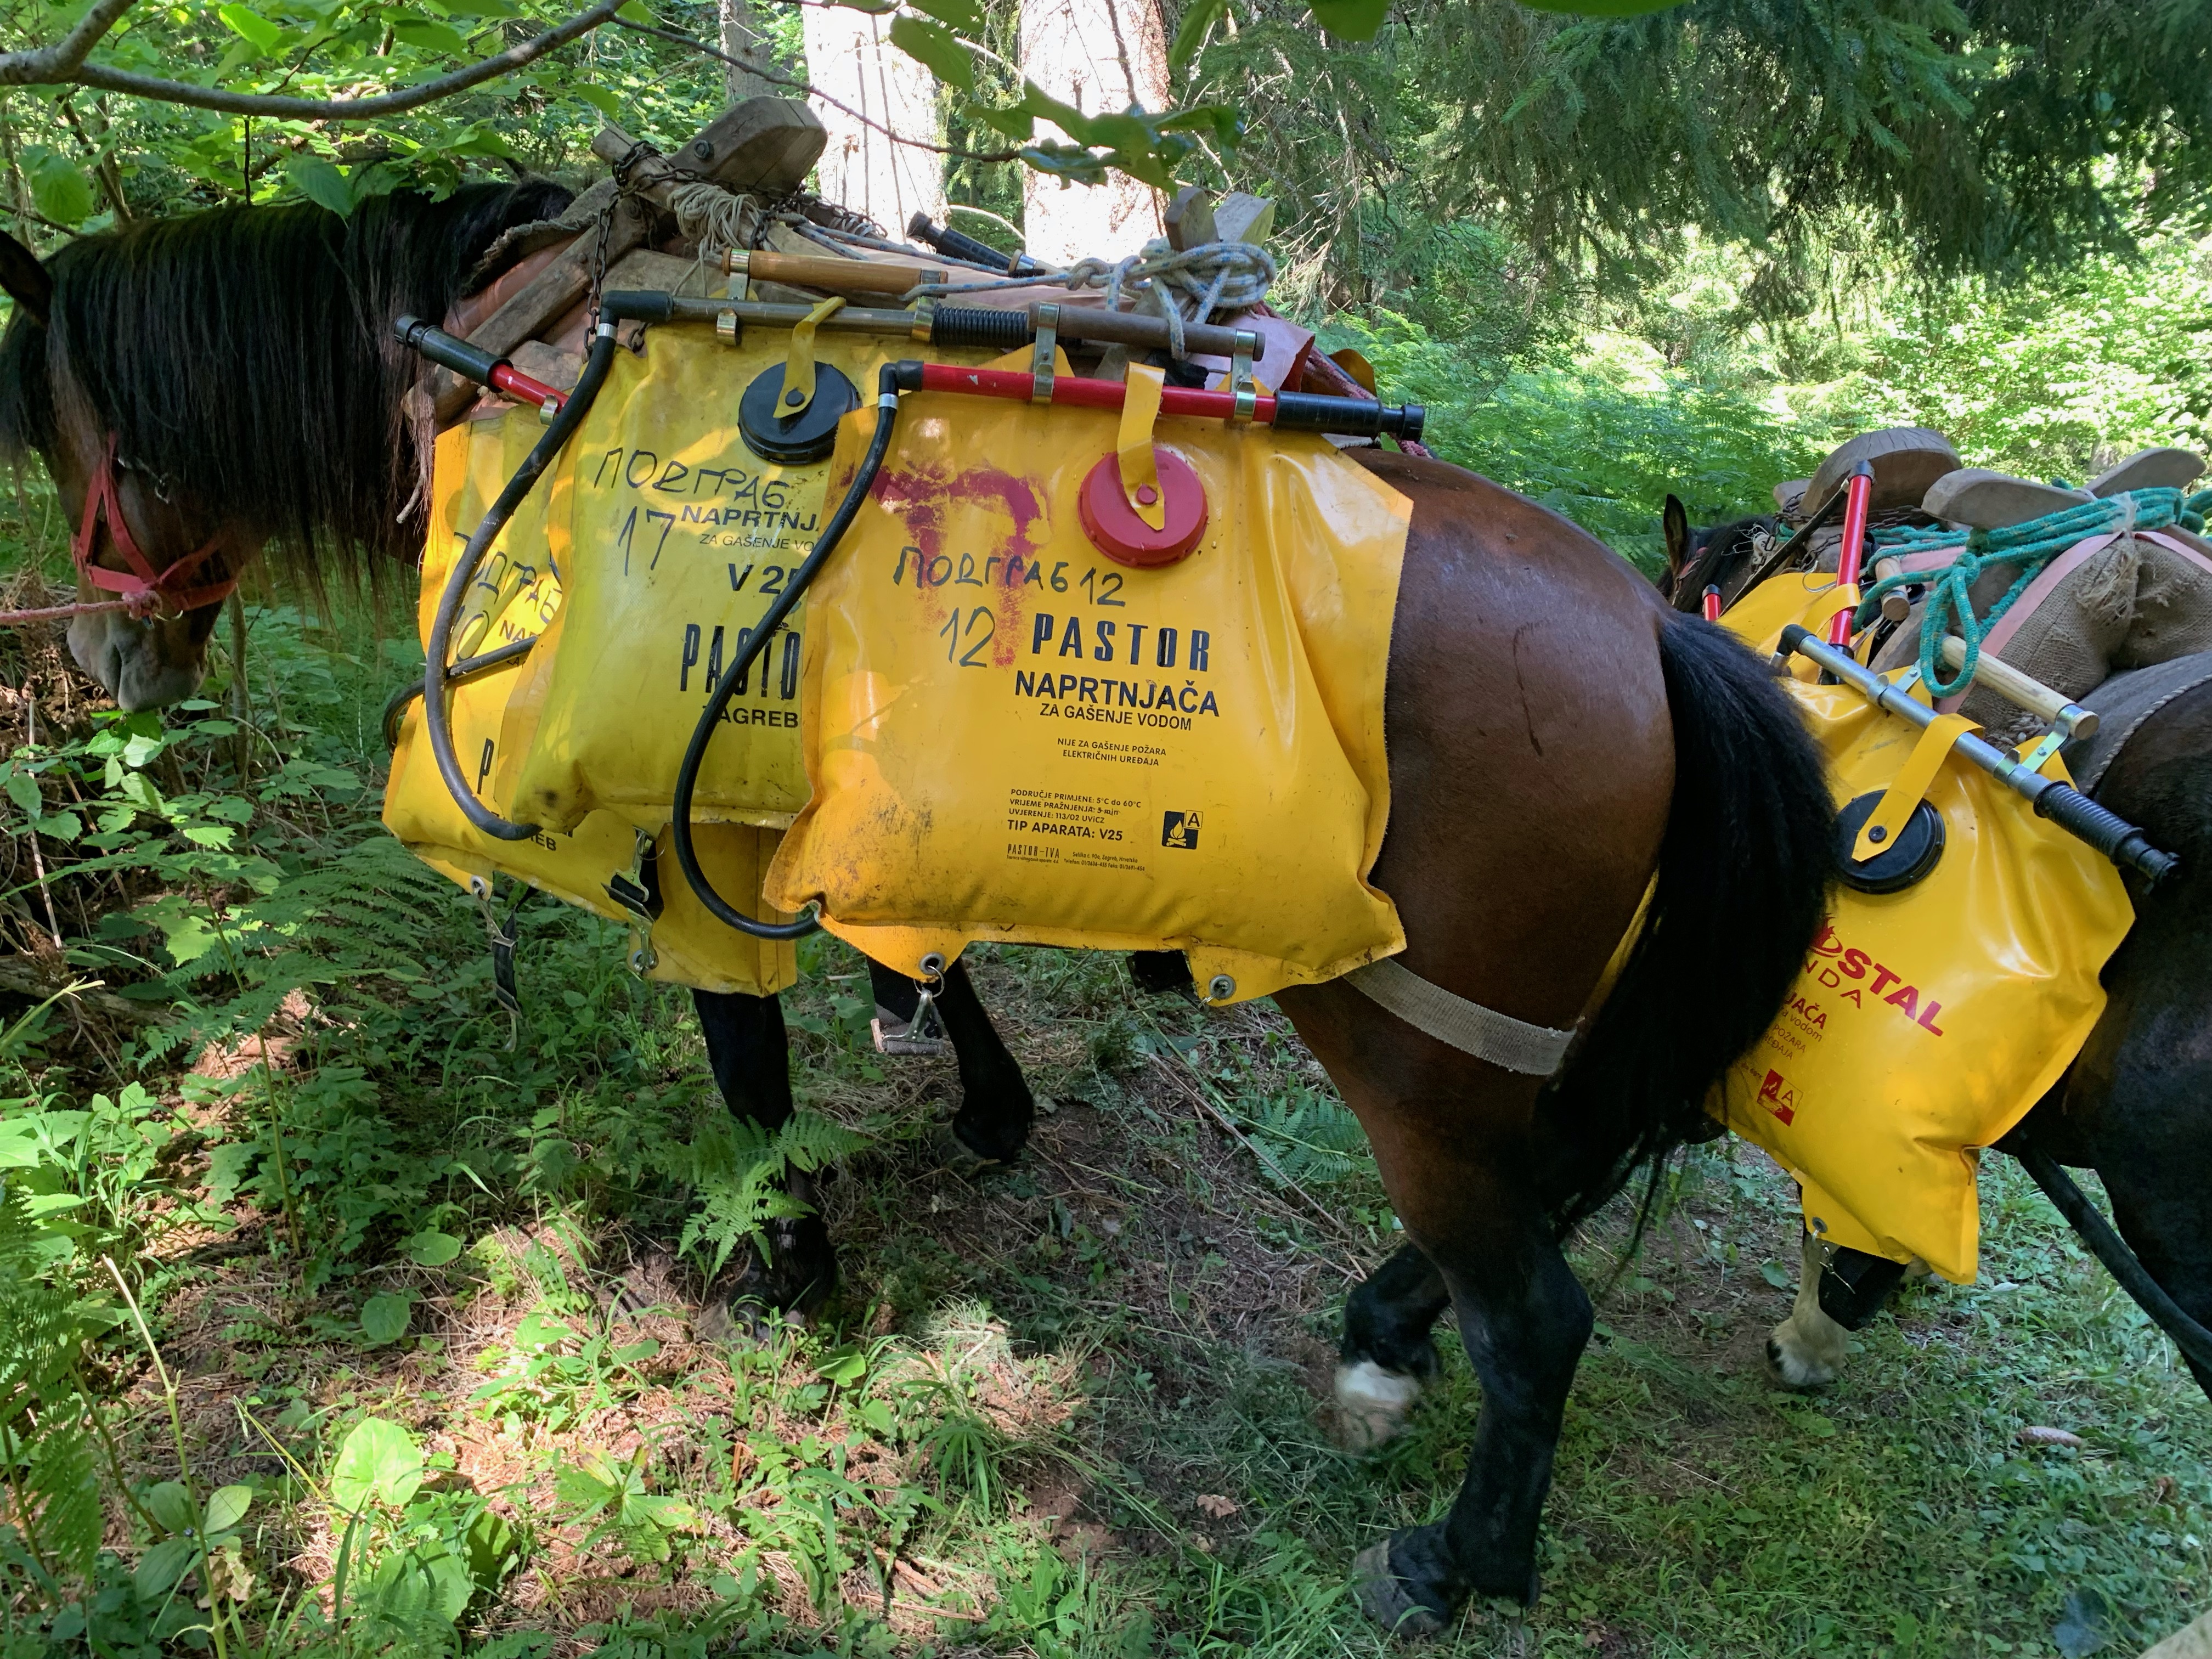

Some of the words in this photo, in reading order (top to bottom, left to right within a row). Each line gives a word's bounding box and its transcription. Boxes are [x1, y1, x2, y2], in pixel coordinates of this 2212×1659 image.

[681, 505, 819, 532] NAPRTNJ
[618, 505, 676, 577] 17
[699, 533, 718, 545] ZA
[723, 534, 790, 549] GAŠENJE
[727, 562, 754, 591] V
[1079, 567, 1126, 607] 12
[940, 606, 995, 668] 12
[1032, 612, 1210, 672] PASTOR
[1015, 670, 1220, 717] NAPRTNJAČA
[702, 706, 799, 728] AGREB
[1040, 703, 1059, 717] ZA
[1064, 704, 1133, 725] GAŠENJE
[1137, 713, 1192, 731] VODOM
[1057, 738, 1076, 747] NIJE
[1078, 740, 1089, 748] ZA
[1092, 741, 1129, 752] GAŠENJE
[1132, 744, 1166, 756] POŽARA
[1063, 749, 1117, 761] ELEKTRIČNIH
[1120, 755, 1159, 766] UREĐAJA
[1009, 798, 1041, 808] VRIJEME
[1044, 802, 1095, 812] PRAŽNJENJA:
[1011, 788, 1052, 799] PODRUČJE
[1054, 793, 1094, 803] PRIMJENE:
[1009, 808, 1053, 818] UVJERENJE:
[1056, 812, 1079, 821] 113/02
[1007, 819, 1028, 831] TIP
[1031, 822, 1095, 838] APARATA:
[1099, 828, 1123, 841] V25
